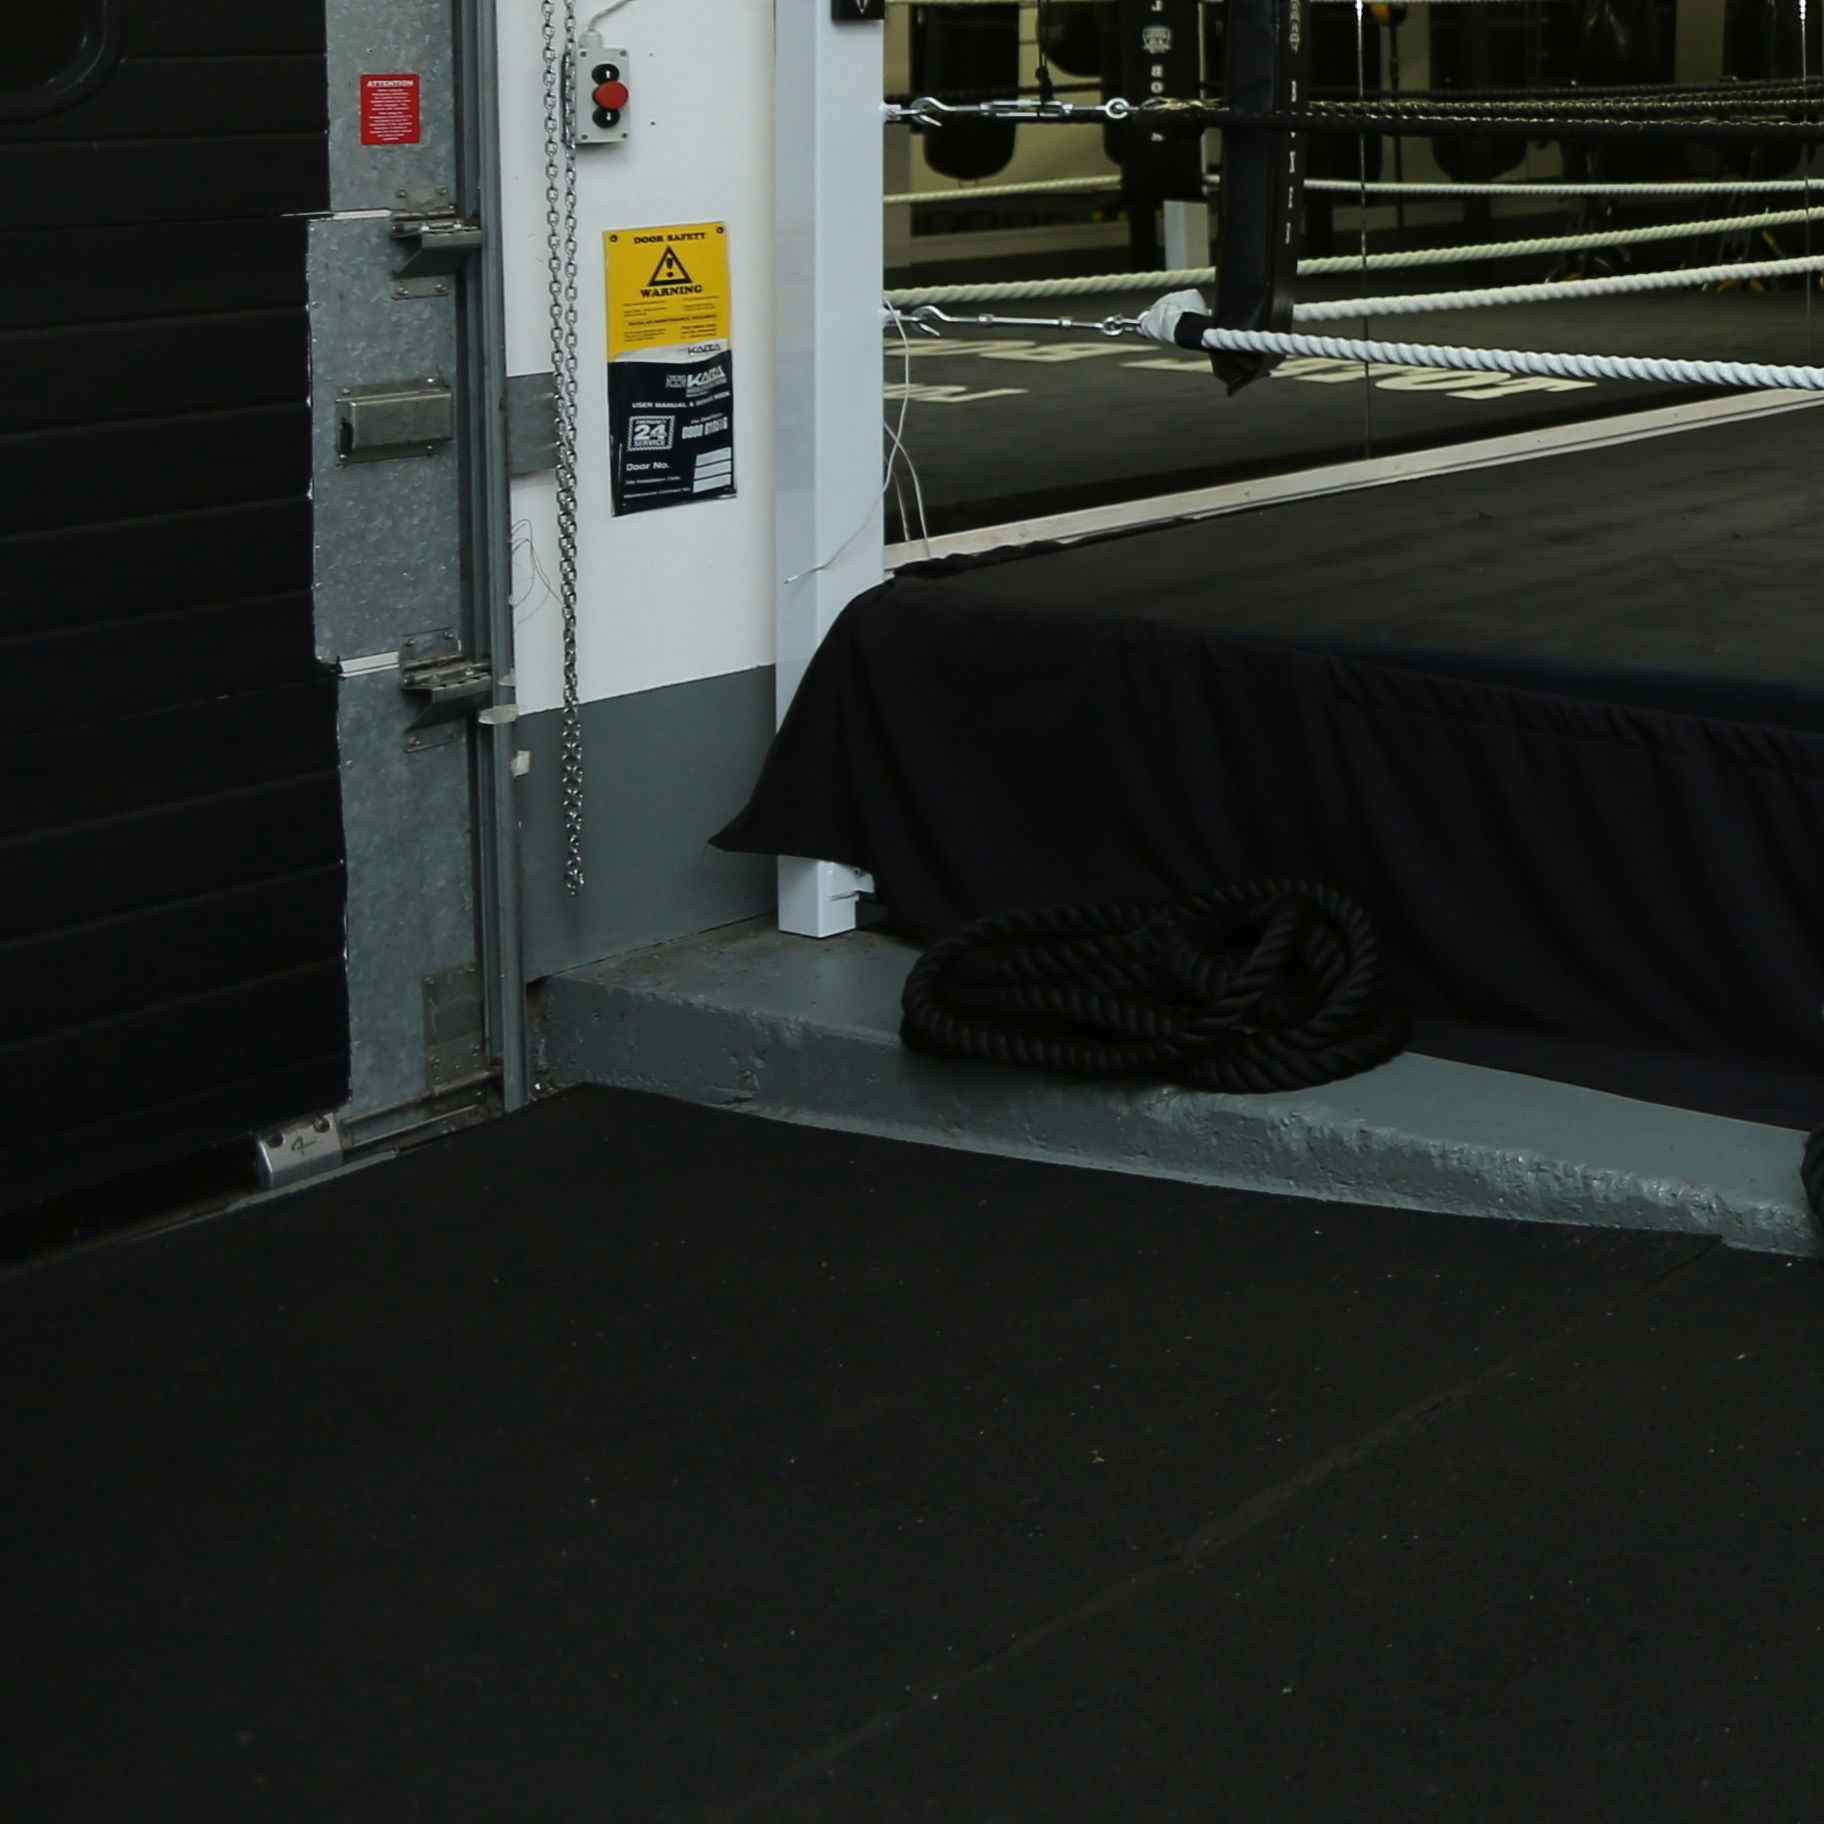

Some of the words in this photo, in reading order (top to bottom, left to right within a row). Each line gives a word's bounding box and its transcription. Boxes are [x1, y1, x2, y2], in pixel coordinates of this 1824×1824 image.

[633, 234, 664, 244] DOOR
[667, 232, 706, 242] SAFETY
[640, 284, 703, 297] WARNING
[634, 424, 668, 440] 24
[626, 463, 651, 471] Door
